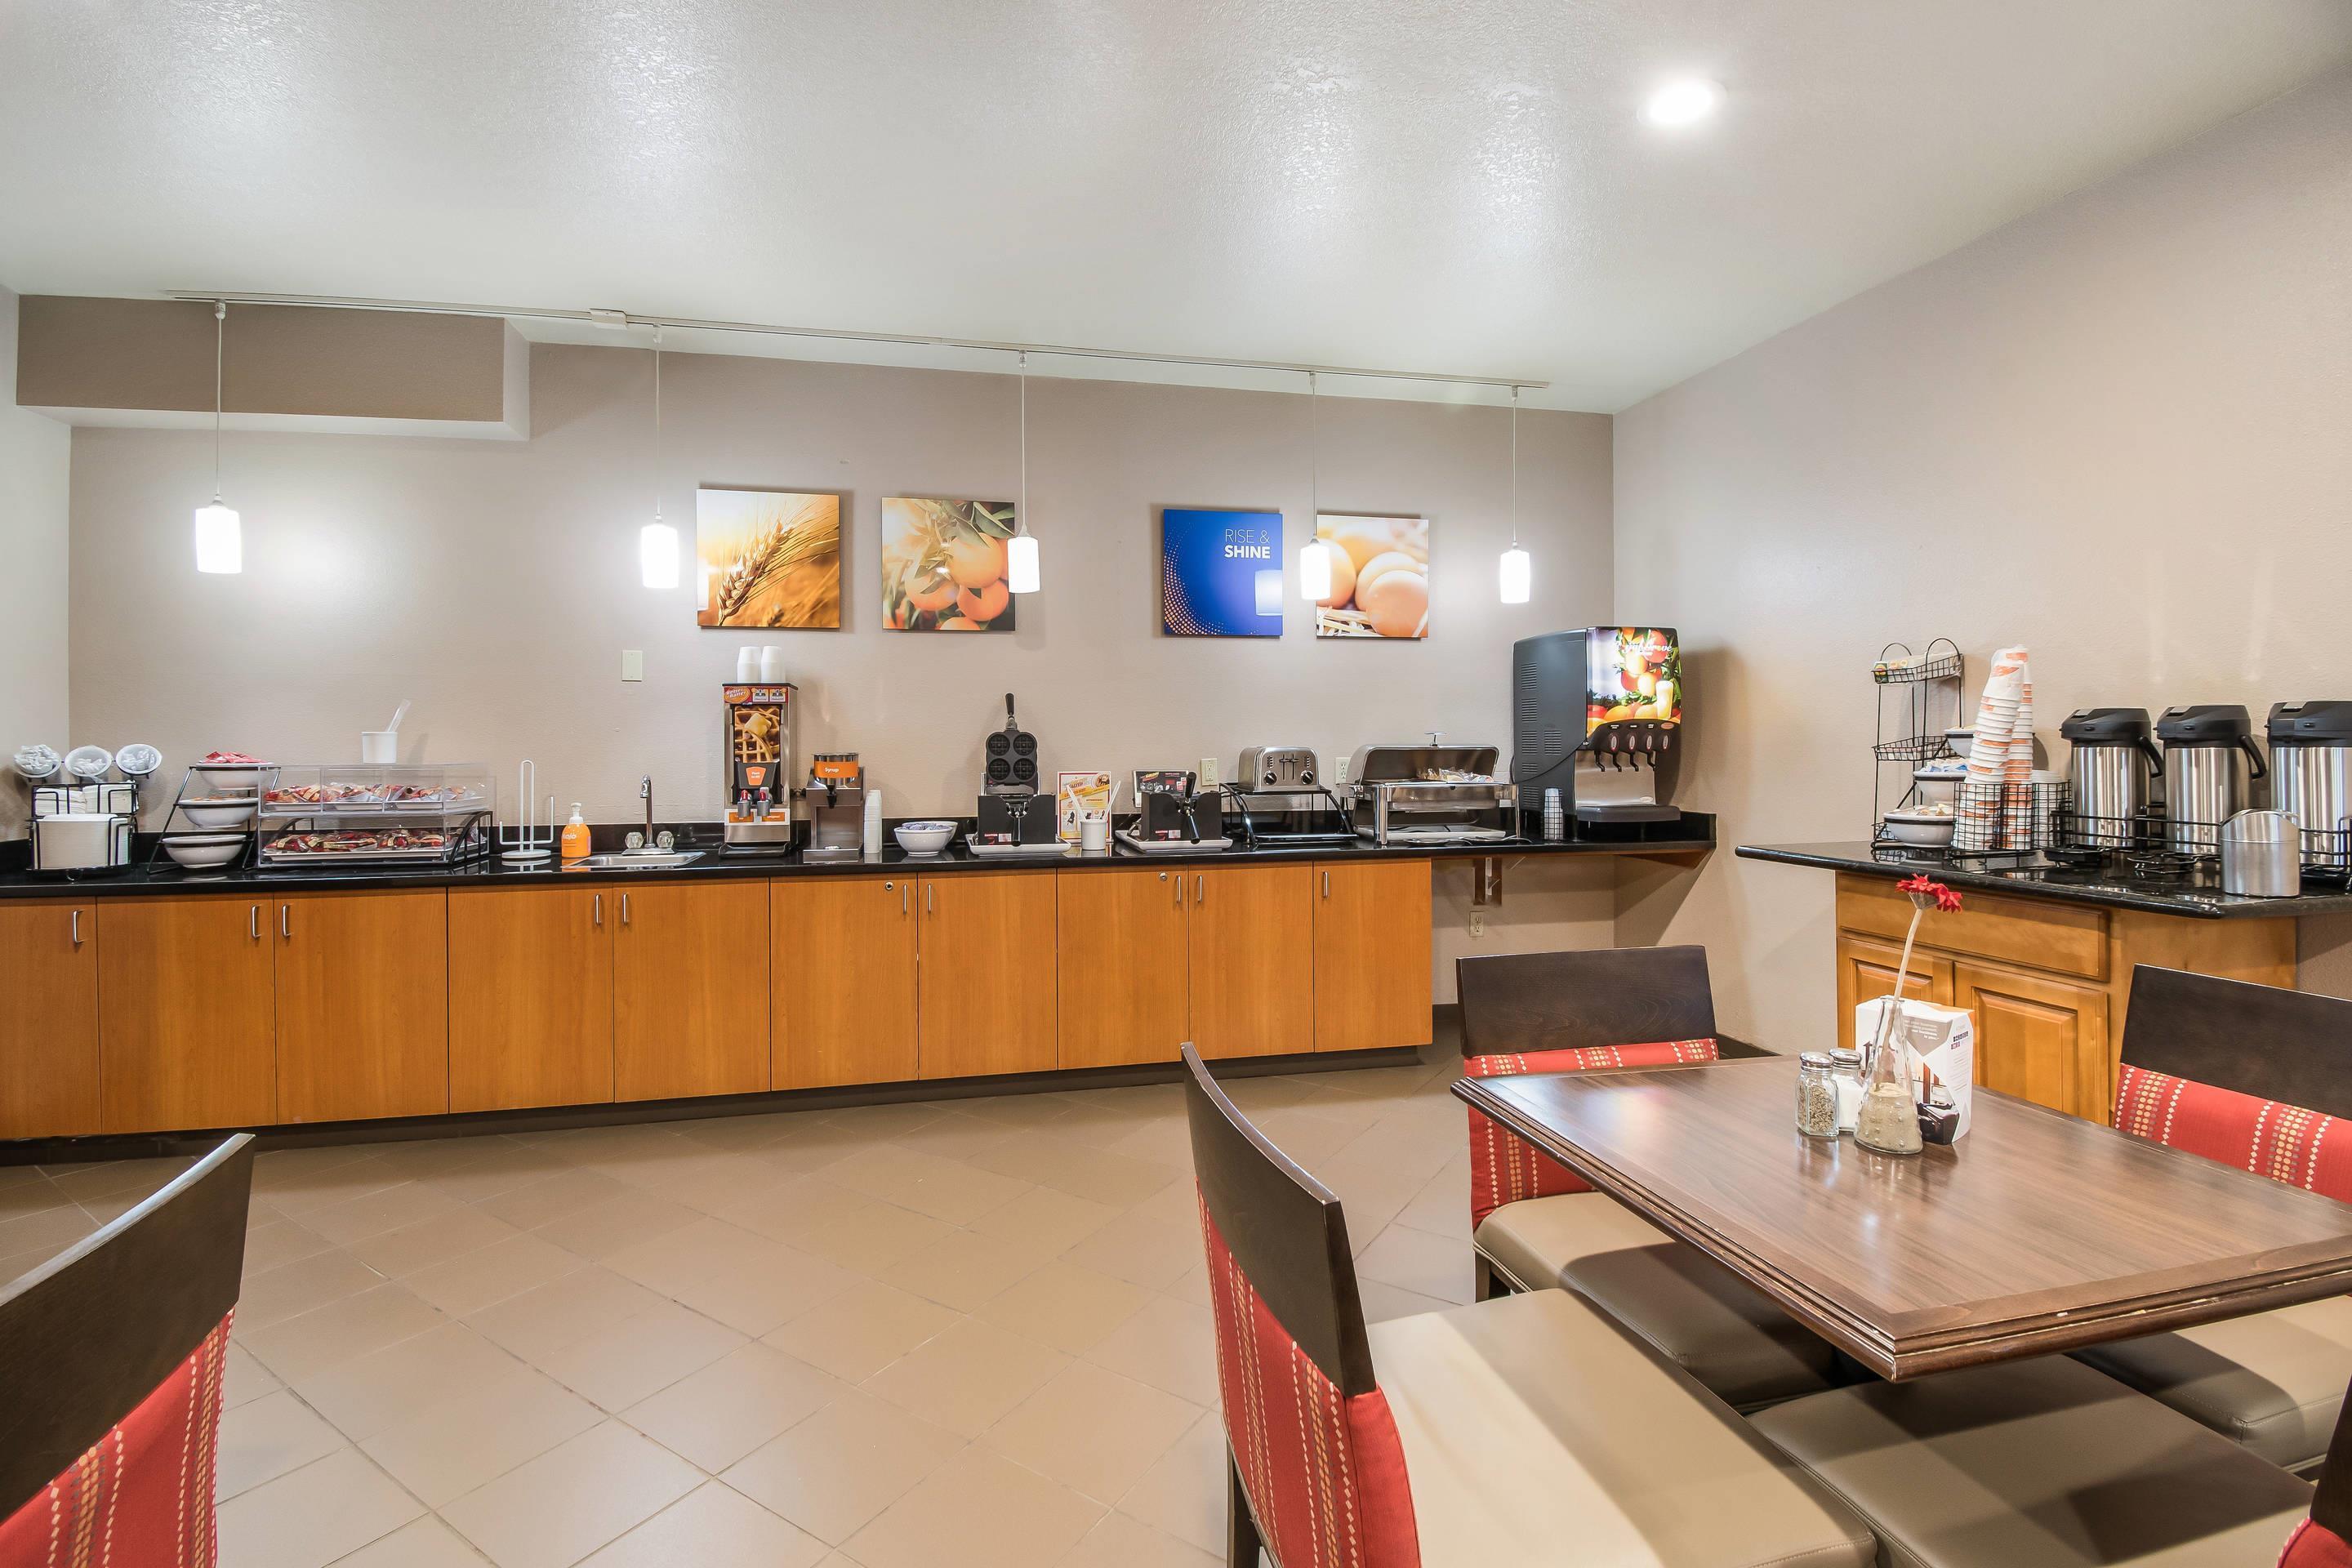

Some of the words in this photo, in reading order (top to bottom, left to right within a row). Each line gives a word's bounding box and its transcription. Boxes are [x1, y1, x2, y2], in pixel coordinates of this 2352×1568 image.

[1225, 528, 1254, 543] RISE
[1259, 529, 1270, 544] &
[1224, 545, 1271, 559] SHINE
